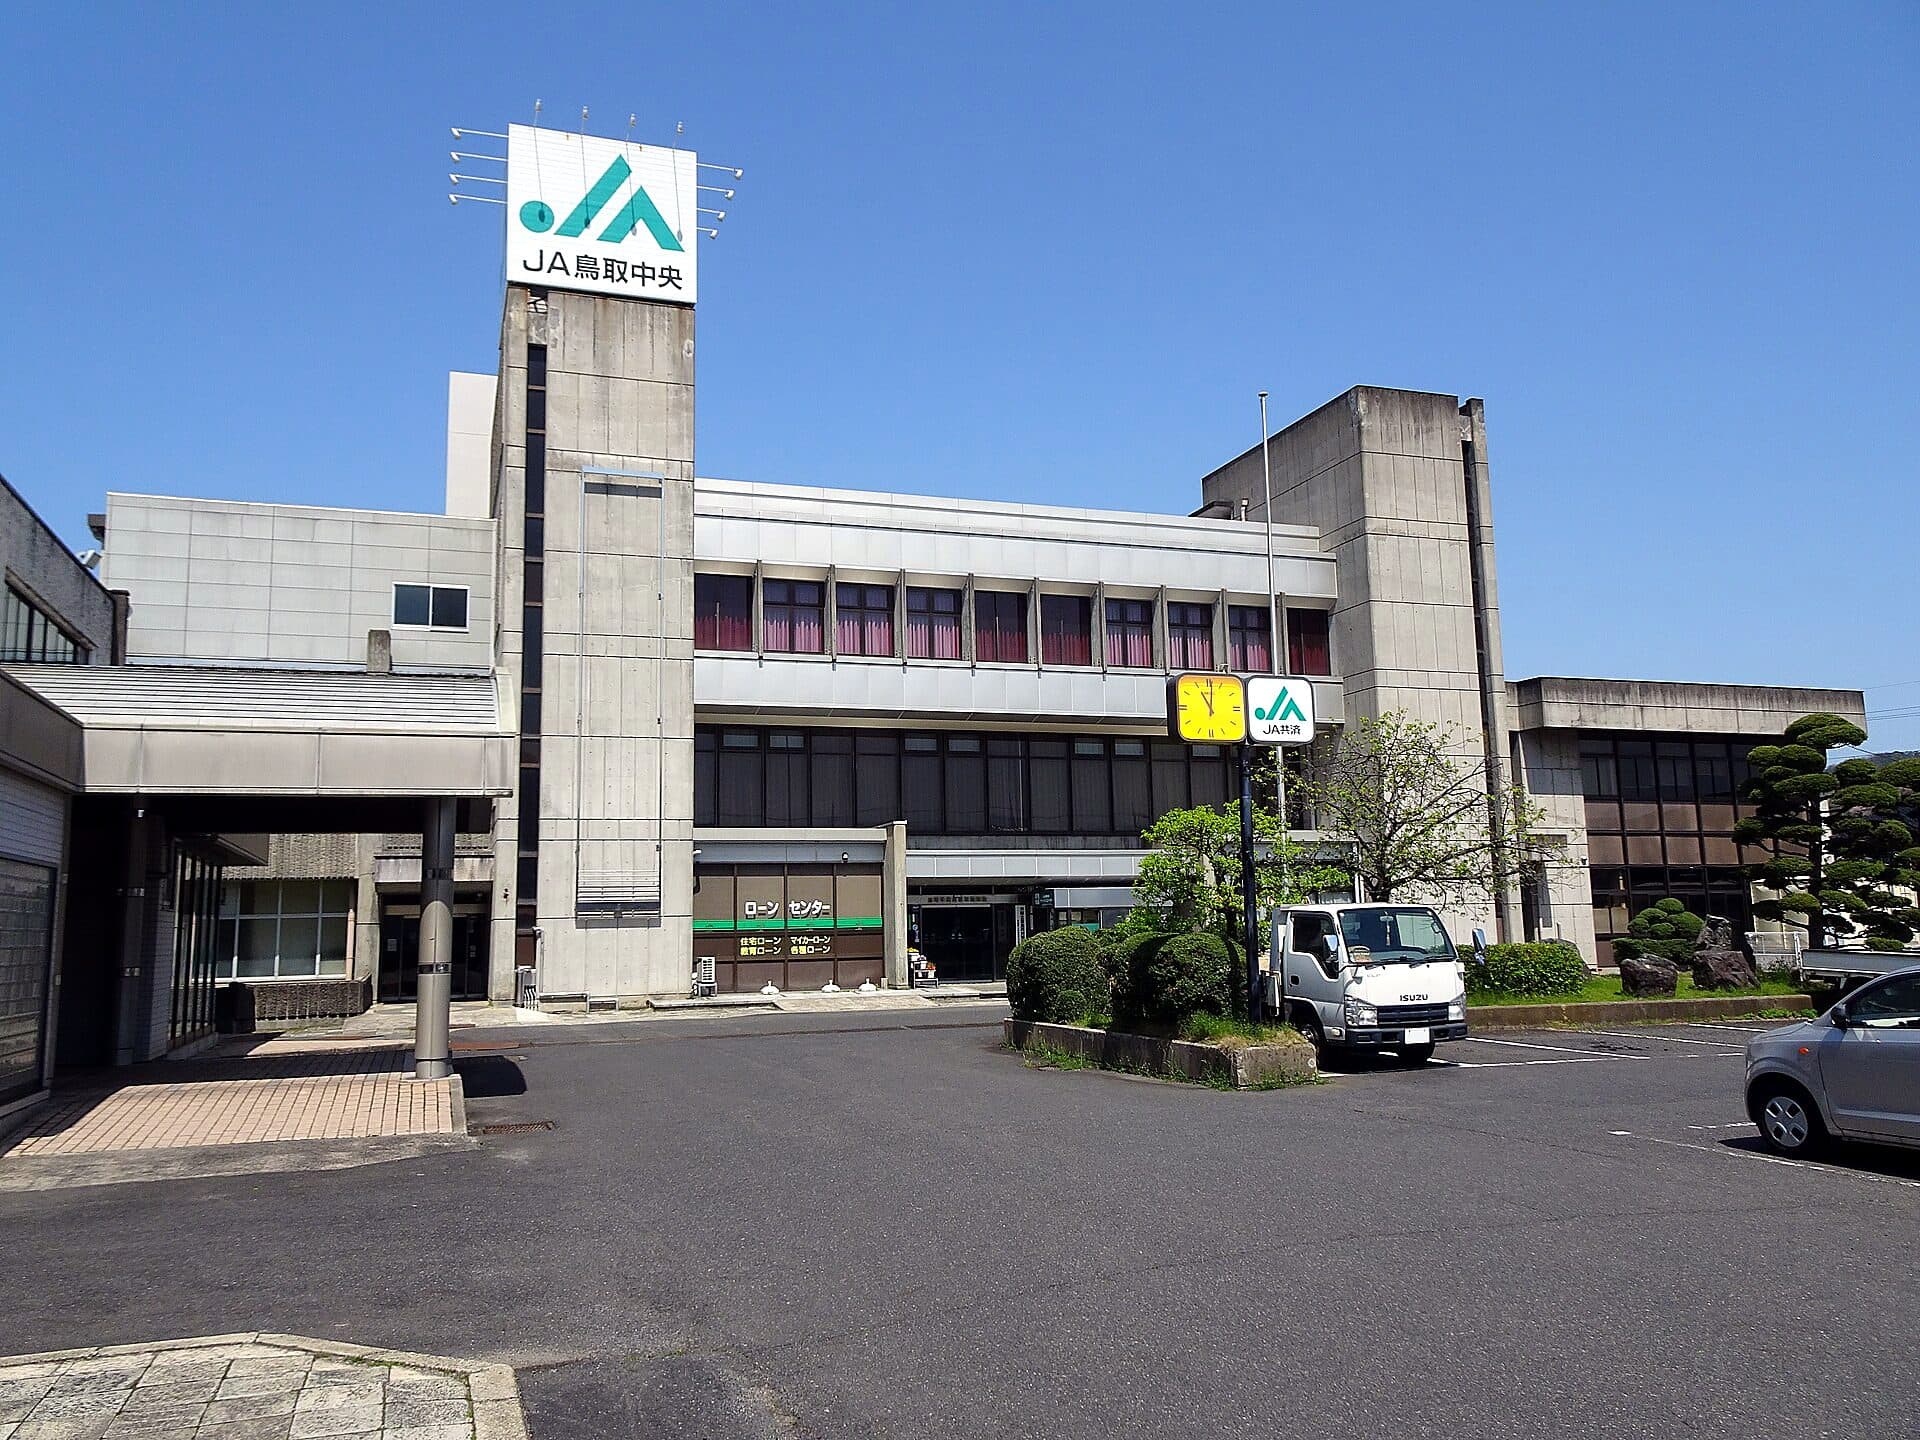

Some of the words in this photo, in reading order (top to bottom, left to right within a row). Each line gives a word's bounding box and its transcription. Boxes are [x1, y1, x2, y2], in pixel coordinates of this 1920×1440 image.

[522, 249, 683, 290] JA鳥取中央
[1262, 724, 1301, 735] JA共済
[745, 901, 779, 918] ローン
[789, 900, 831, 918] センター
[740, 937, 782, 946] 住宅ローン
[790, 935, 831, 945] マイカーローン
[1400, 994, 1429, 1002] ISUZU
